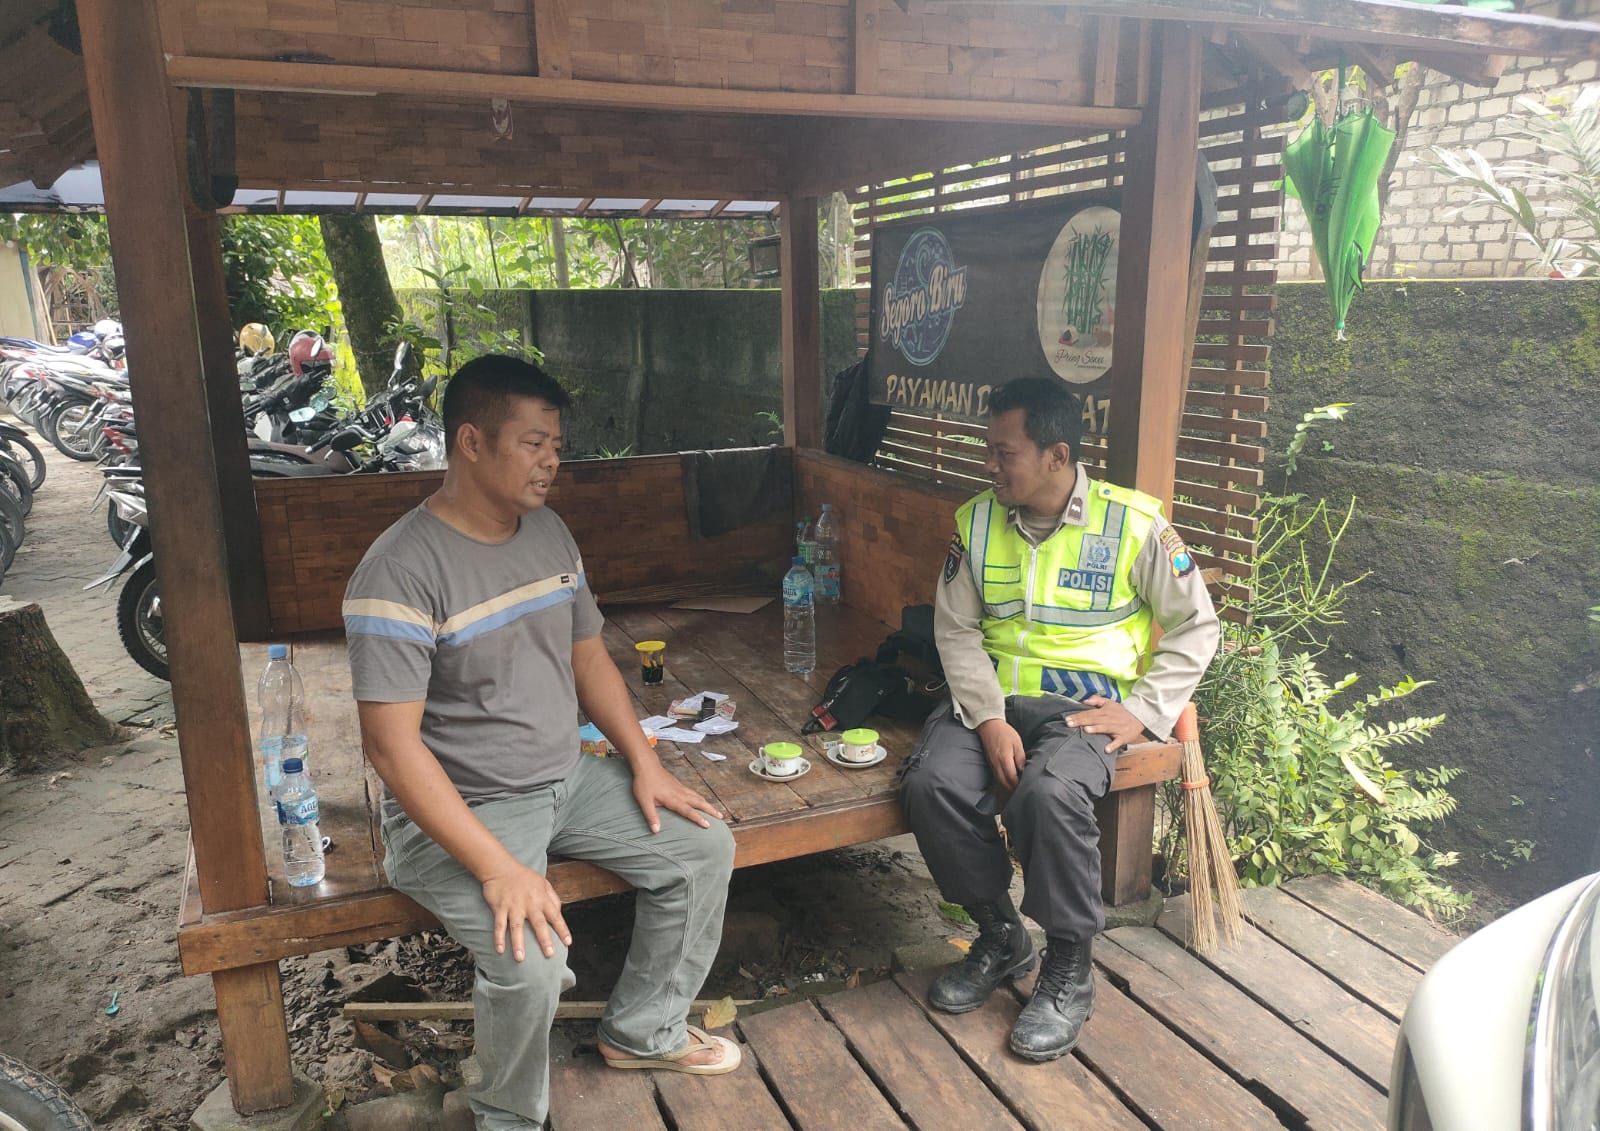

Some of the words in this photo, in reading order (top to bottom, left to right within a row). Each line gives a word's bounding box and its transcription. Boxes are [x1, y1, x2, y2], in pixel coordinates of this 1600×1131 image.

[881, 288, 926, 345] Segoro
[929, 265, 965, 313] Biru
[886, 374, 974, 417] PAYAMAN
[1086, 562, 1108, 571] POLRI
[1059, 570, 1112, 593] POLISI
[300, 800, 318, 814] AQU
